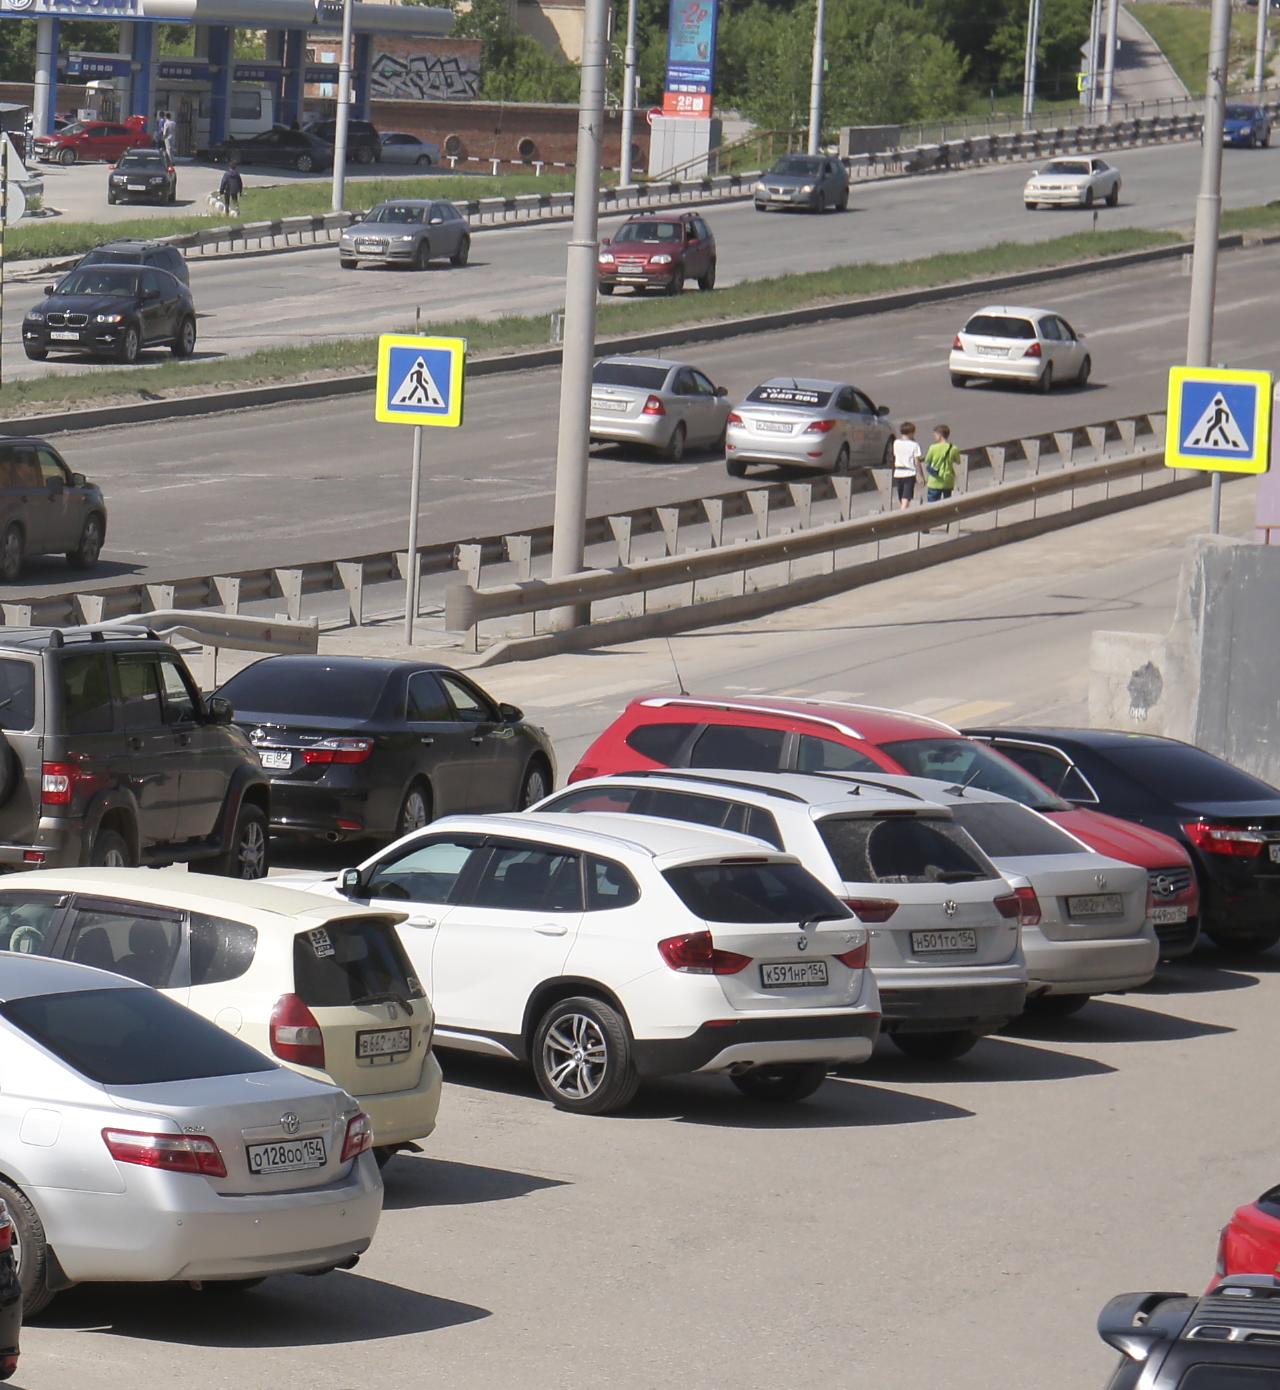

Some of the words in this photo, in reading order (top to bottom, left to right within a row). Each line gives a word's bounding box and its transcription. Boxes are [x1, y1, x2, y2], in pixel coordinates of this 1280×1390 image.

[916, 933, 957, 949] Н501ТО
[766, 966, 807, 982] К591НР
[254, 1146, 303, 1167] О128ОО
[303, 1140, 323, 1157] 154
